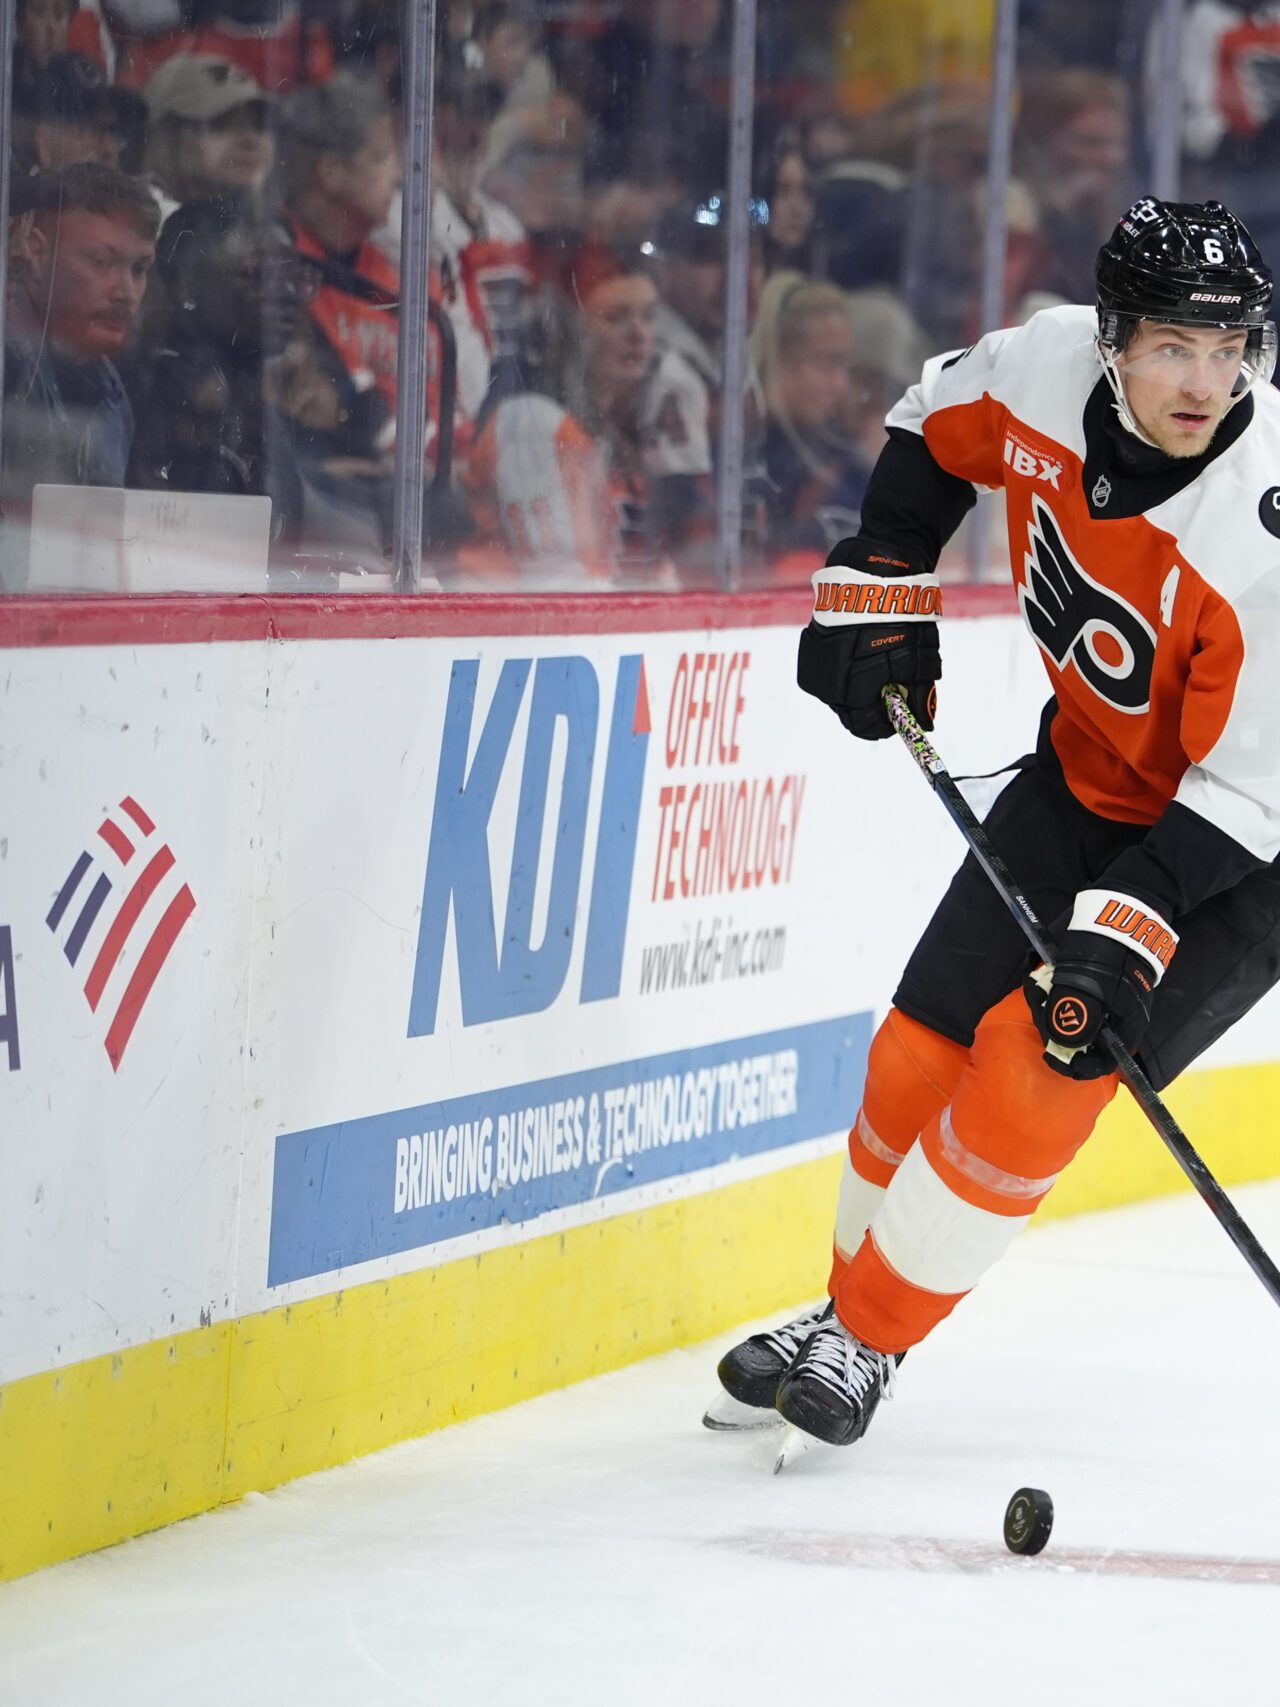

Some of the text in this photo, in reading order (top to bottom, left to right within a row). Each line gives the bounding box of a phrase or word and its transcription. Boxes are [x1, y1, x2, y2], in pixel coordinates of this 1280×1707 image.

[1203, 238, 1224, 264] 6
[1189, 292, 1242, 304] BAUER
[1003, 438, 1063, 492] IBX
[1006, 430, 1056, 463] Independence
[1160, 563, 1181, 629] A
[871, 634, 905, 648] COVERT
[666, 652, 751, 769] OFFICE
[406, 653, 652, 1039] KDI
[652, 774, 807, 902] TECHNOLOGY
[1015, 894, 1039, 924] SANHEIM
[640, 915, 787, 995] www.kdi-inc.com
[393, 1048, 799, 1214] BRINGING BUSINESS & TECHNOLOGY TOGETHER
